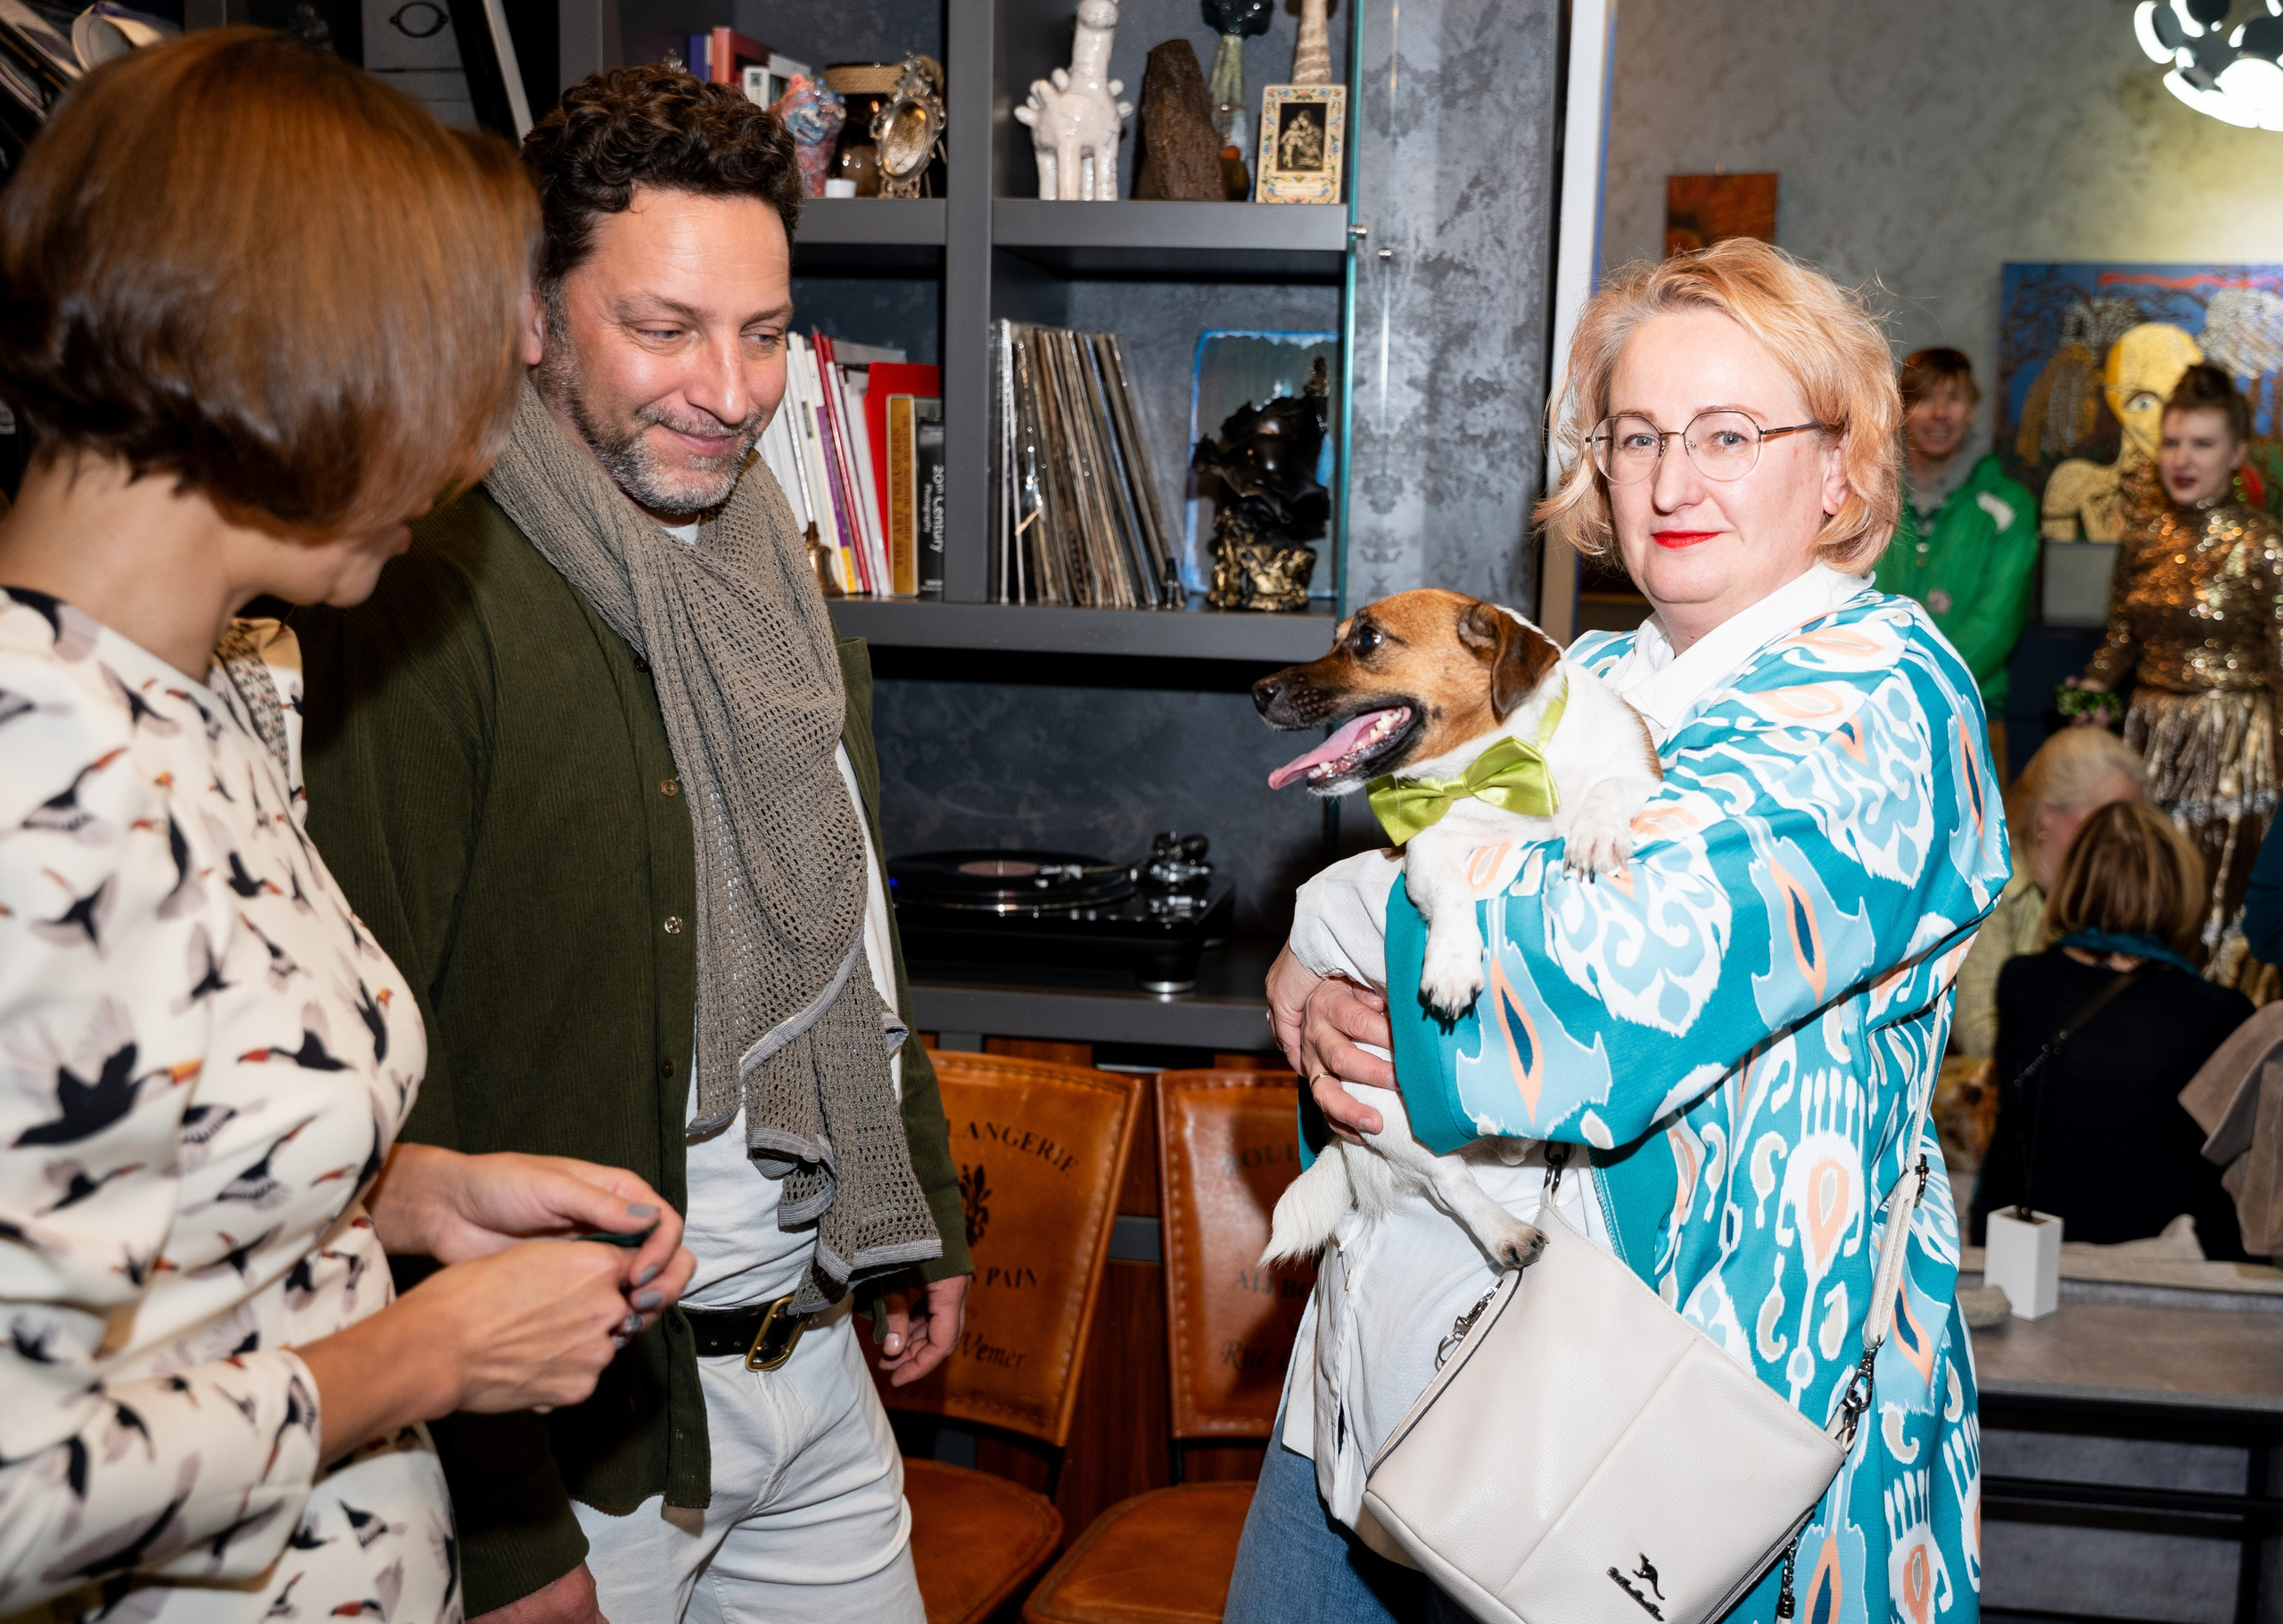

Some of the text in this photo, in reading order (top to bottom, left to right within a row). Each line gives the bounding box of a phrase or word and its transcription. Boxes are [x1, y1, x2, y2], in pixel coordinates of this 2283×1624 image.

[922, 483, 933, 534] Photography
[928, 496, 944, 554] Century
[985, 1266, 1037, 1289] PAIN
